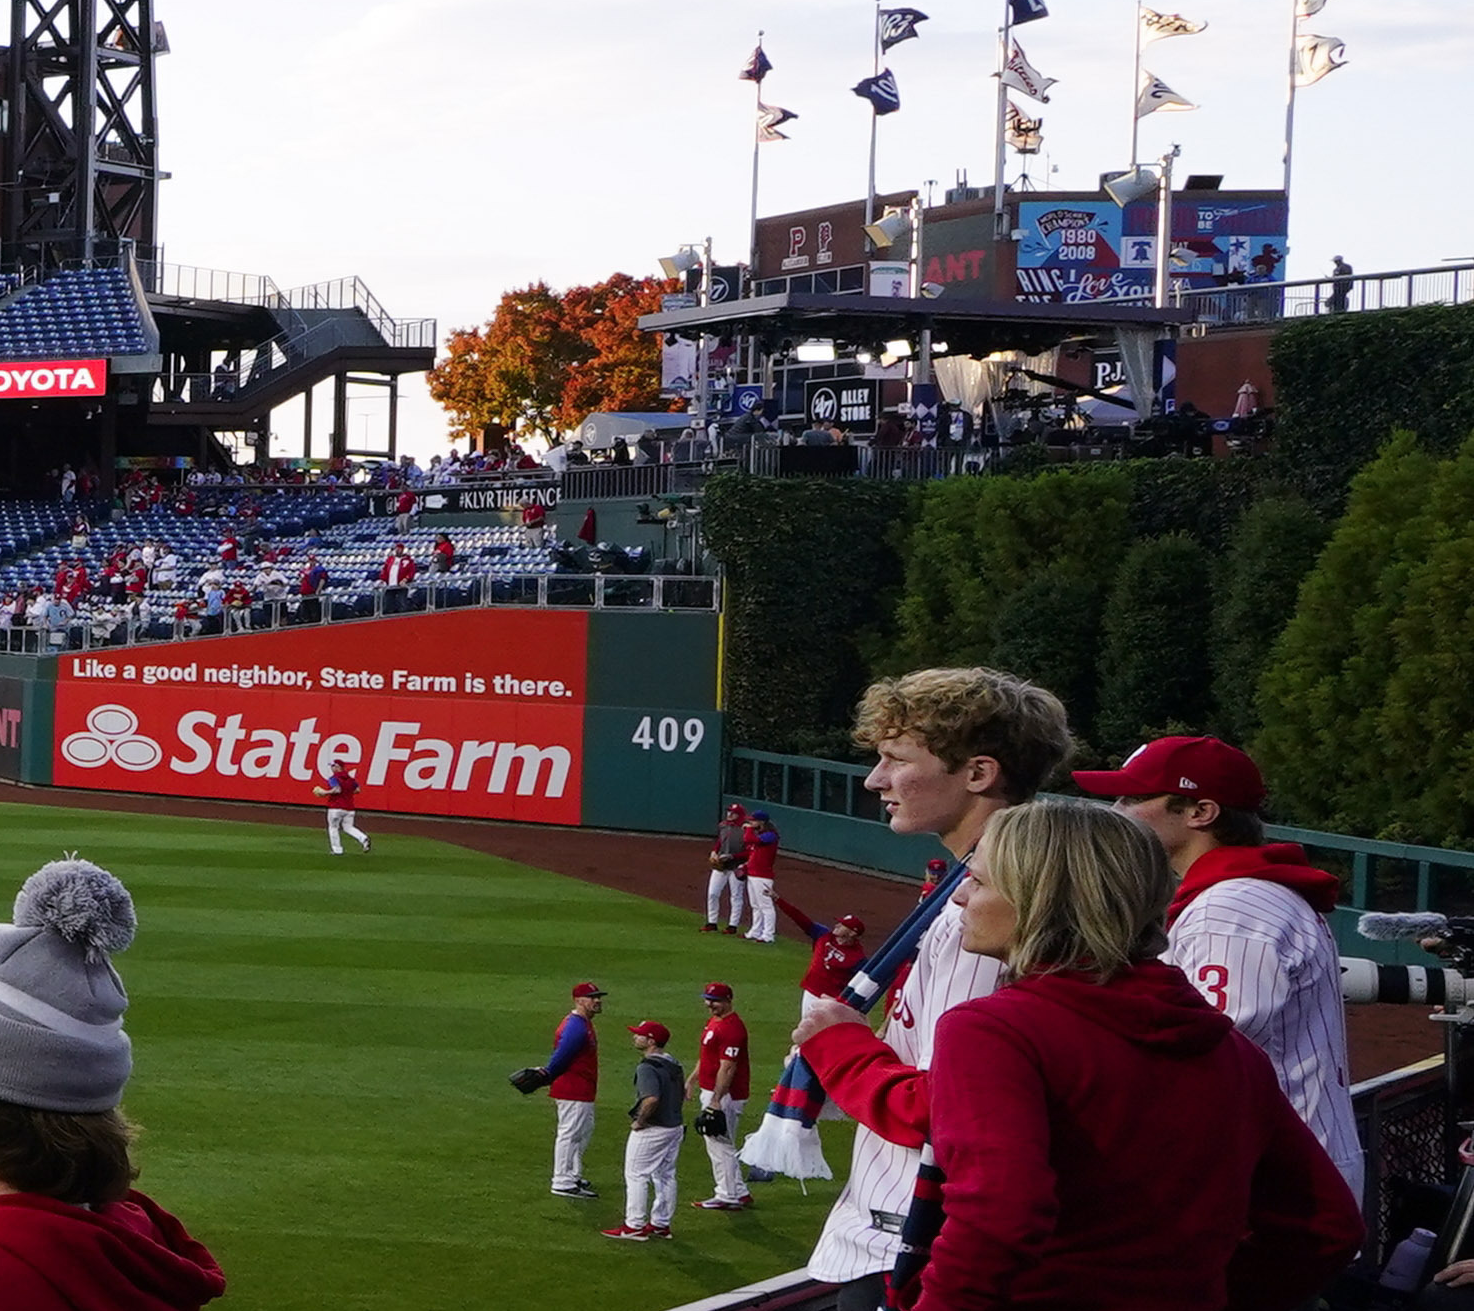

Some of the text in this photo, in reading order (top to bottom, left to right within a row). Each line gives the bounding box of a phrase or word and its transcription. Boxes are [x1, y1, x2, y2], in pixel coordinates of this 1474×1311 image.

[1197, 210, 1214, 220] TO
[1197, 221, 1213, 230] BE
[1059, 228, 1096, 244] 1980
[1058, 245, 1096, 261] 2008
[840, 388, 870, 405] ALLEY
[840, 405, 871, 422] STORE
[73, 658, 573, 697] Like a good neighbor, State Farm is there.
[631, 715, 705, 754] 409
[1197, 964, 1230, 1013] 3
[723, 1046, 740, 1059] 47
